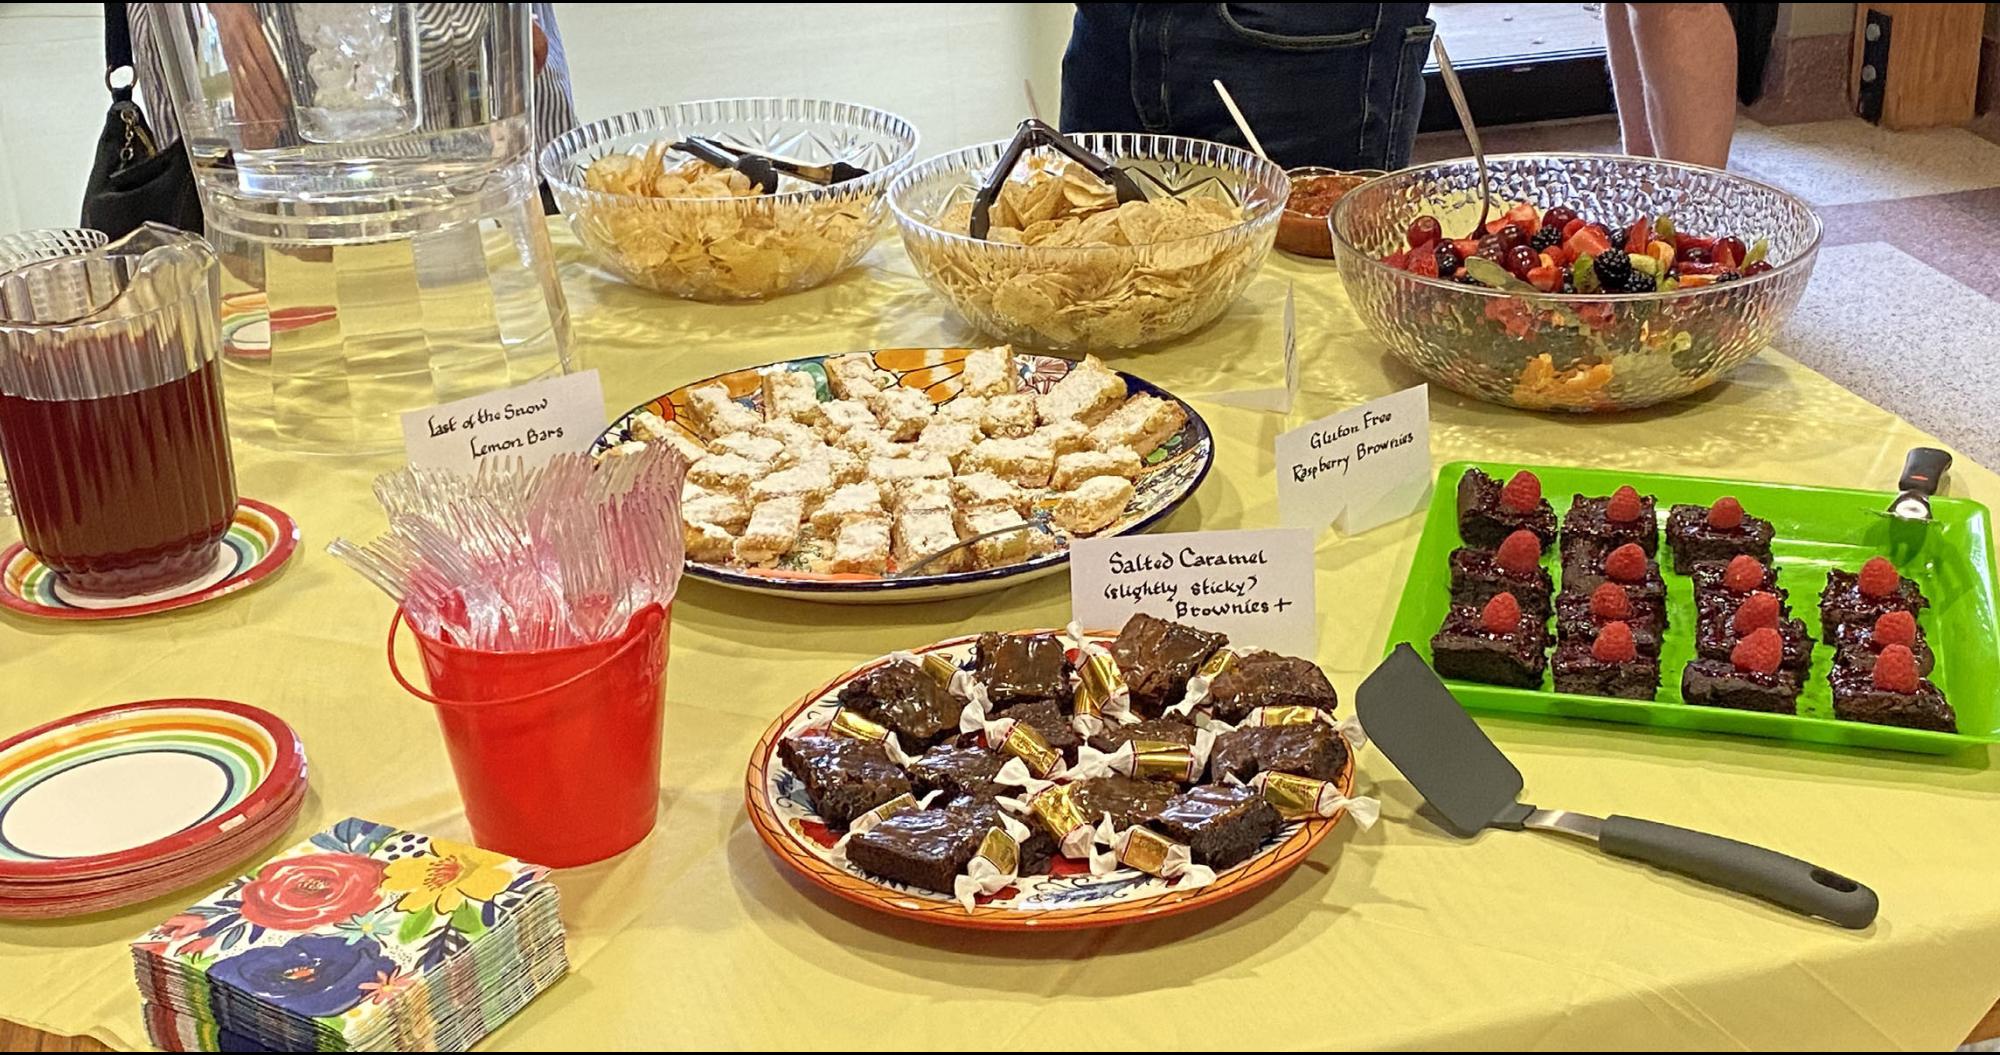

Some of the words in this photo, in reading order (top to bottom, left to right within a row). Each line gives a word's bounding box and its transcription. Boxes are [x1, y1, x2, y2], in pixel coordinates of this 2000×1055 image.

[428, 415, 457, 438] Last
[462, 416, 476, 430] of
[477, 408, 501, 424] the
[504, 399, 548, 420] Snow
[1363, 411, 1392, 430] Free
[470, 437, 523, 460] Lemon
[527, 426, 564, 445] Bars
[1292, 455, 1350, 482] Raspberry
[1356, 432, 1414, 461] Brownies
[1109, 551, 1174, 574] Salted
[1179, 547, 1267, 568] Caramel
[1104, 580, 1177, 604] (slightly
[1175, 598, 1269, 619] Brownies
